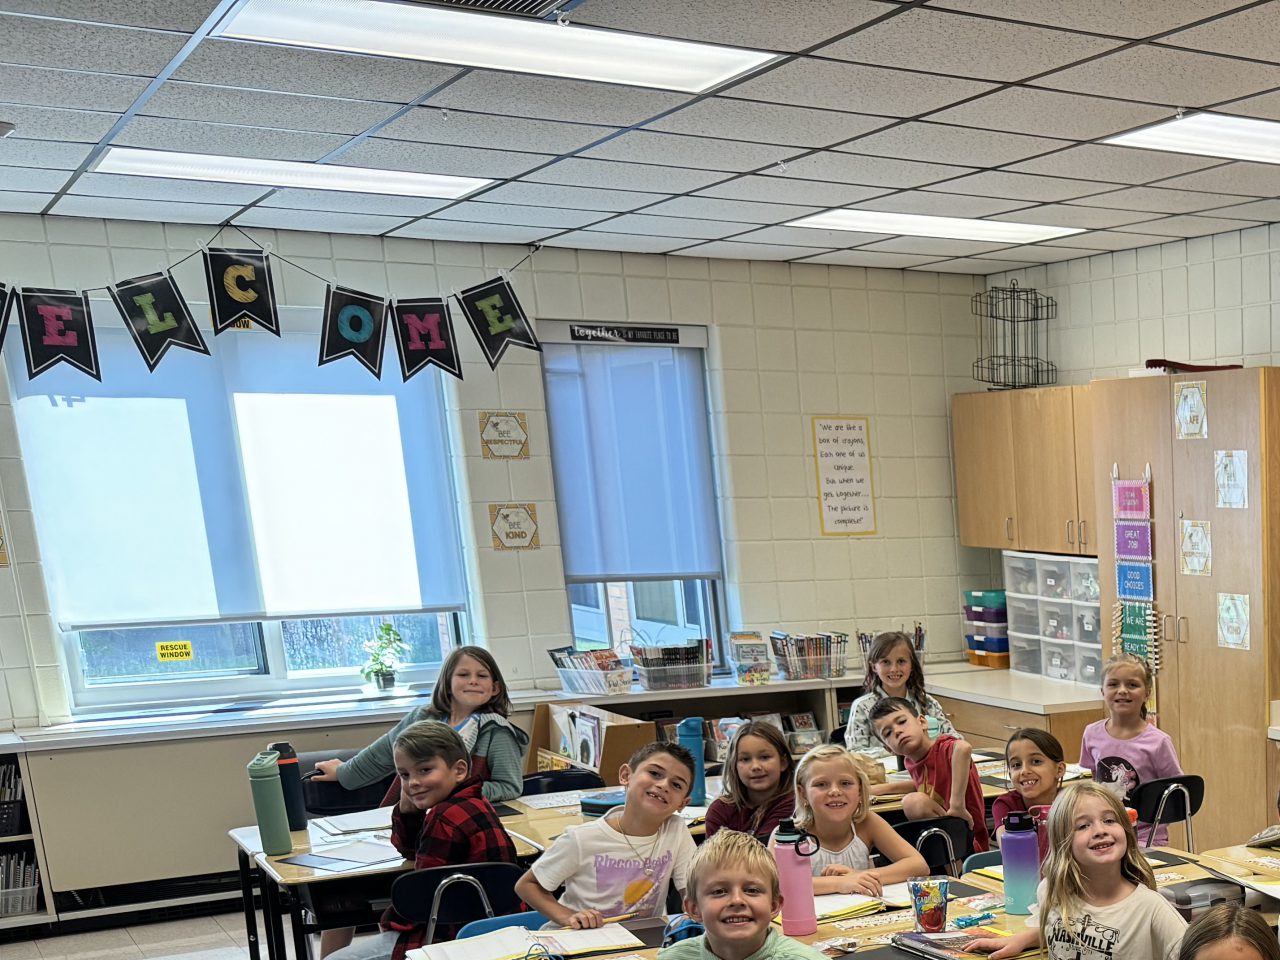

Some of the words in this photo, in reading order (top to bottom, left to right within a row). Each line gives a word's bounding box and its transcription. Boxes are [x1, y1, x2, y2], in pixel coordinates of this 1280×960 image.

[574, 326, 619, 340] together
[1186, 415, 1199, 424] AFE
[505, 531, 528, 540] KIND
[1125, 530, 1140, 539] GREAT
[1127, 571, 1140, 579] GOOD
[1124, 581, 1144, 590] CHOICES
[160, 643, 188, 651] RESCUE
[594, 854, 640, 869] Rincon
[1048, 928, 1116, 953] NASHVILLE
